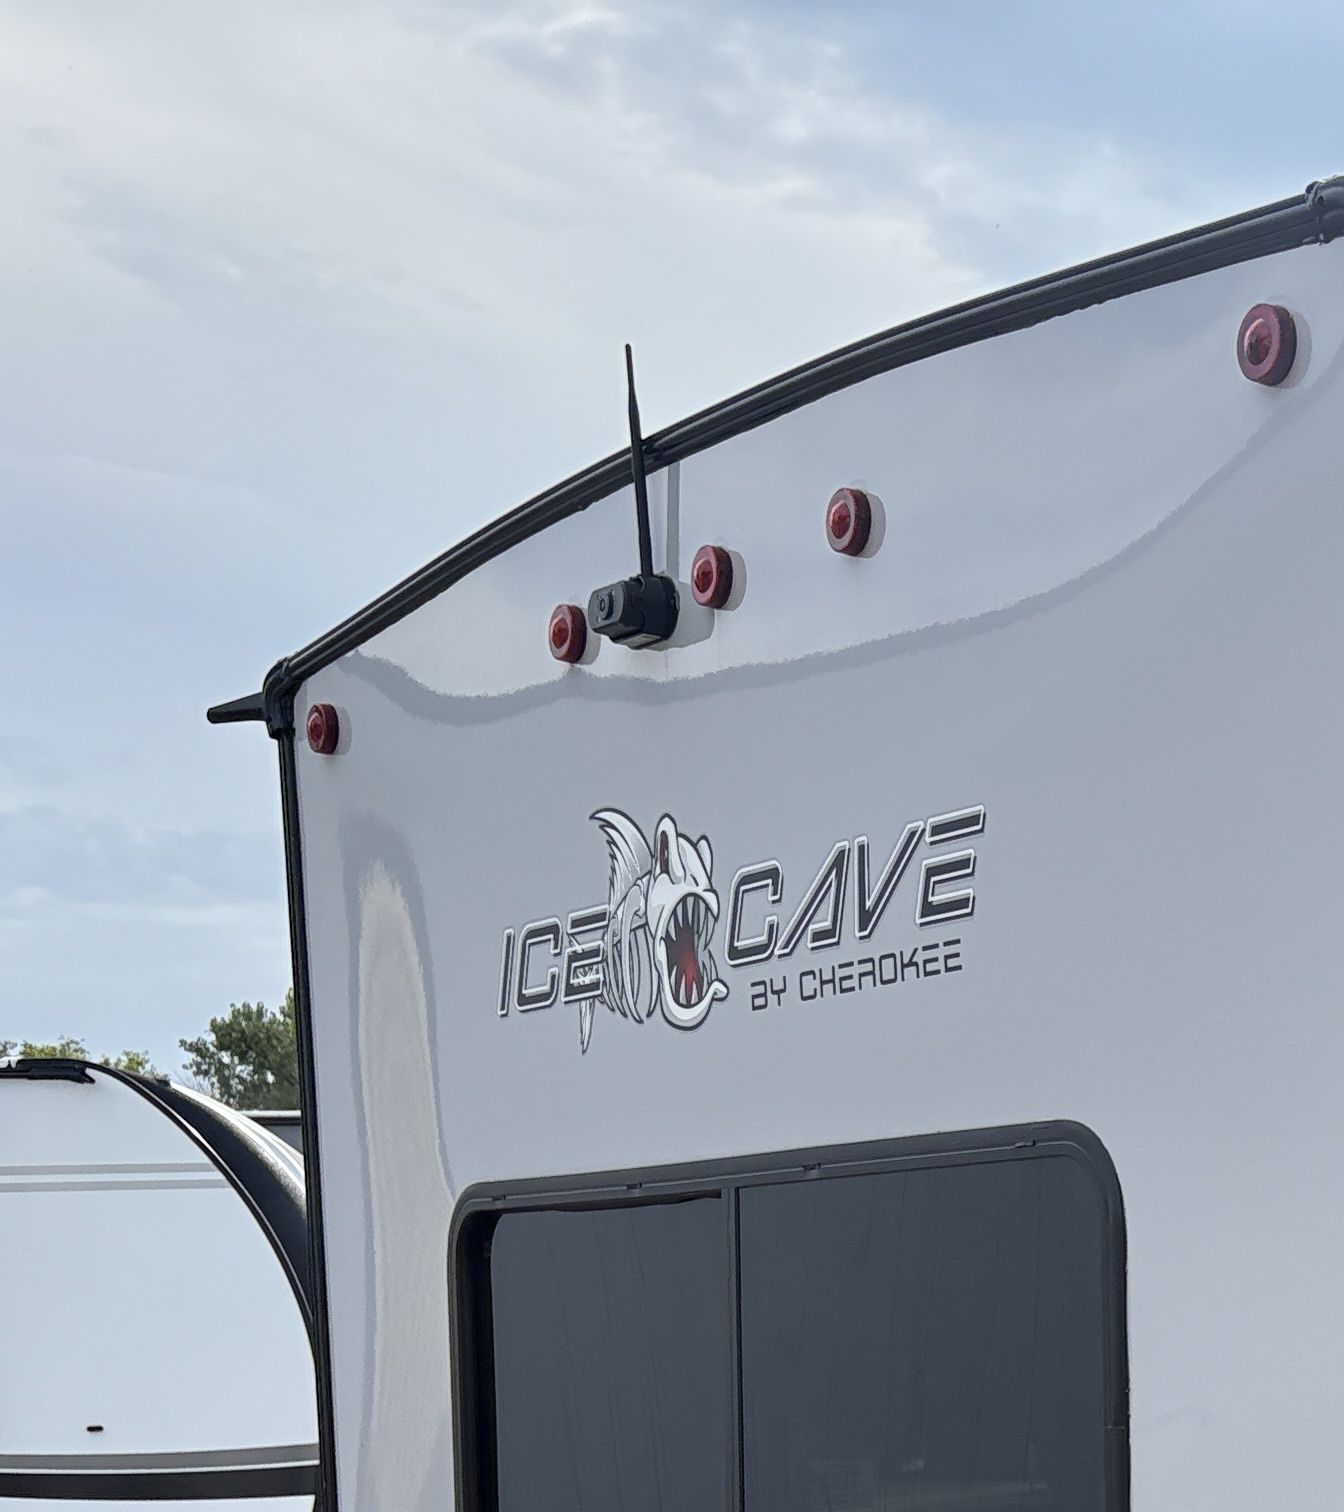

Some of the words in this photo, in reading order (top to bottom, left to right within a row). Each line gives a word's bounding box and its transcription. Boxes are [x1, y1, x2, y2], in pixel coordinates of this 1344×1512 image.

[497, 904, 610, 1017] ICE
[725, 804, 986, 966] CAVE
[751, 973, 787, 1011] BY
[799, 938, 964, 1002] CHEROKEE
